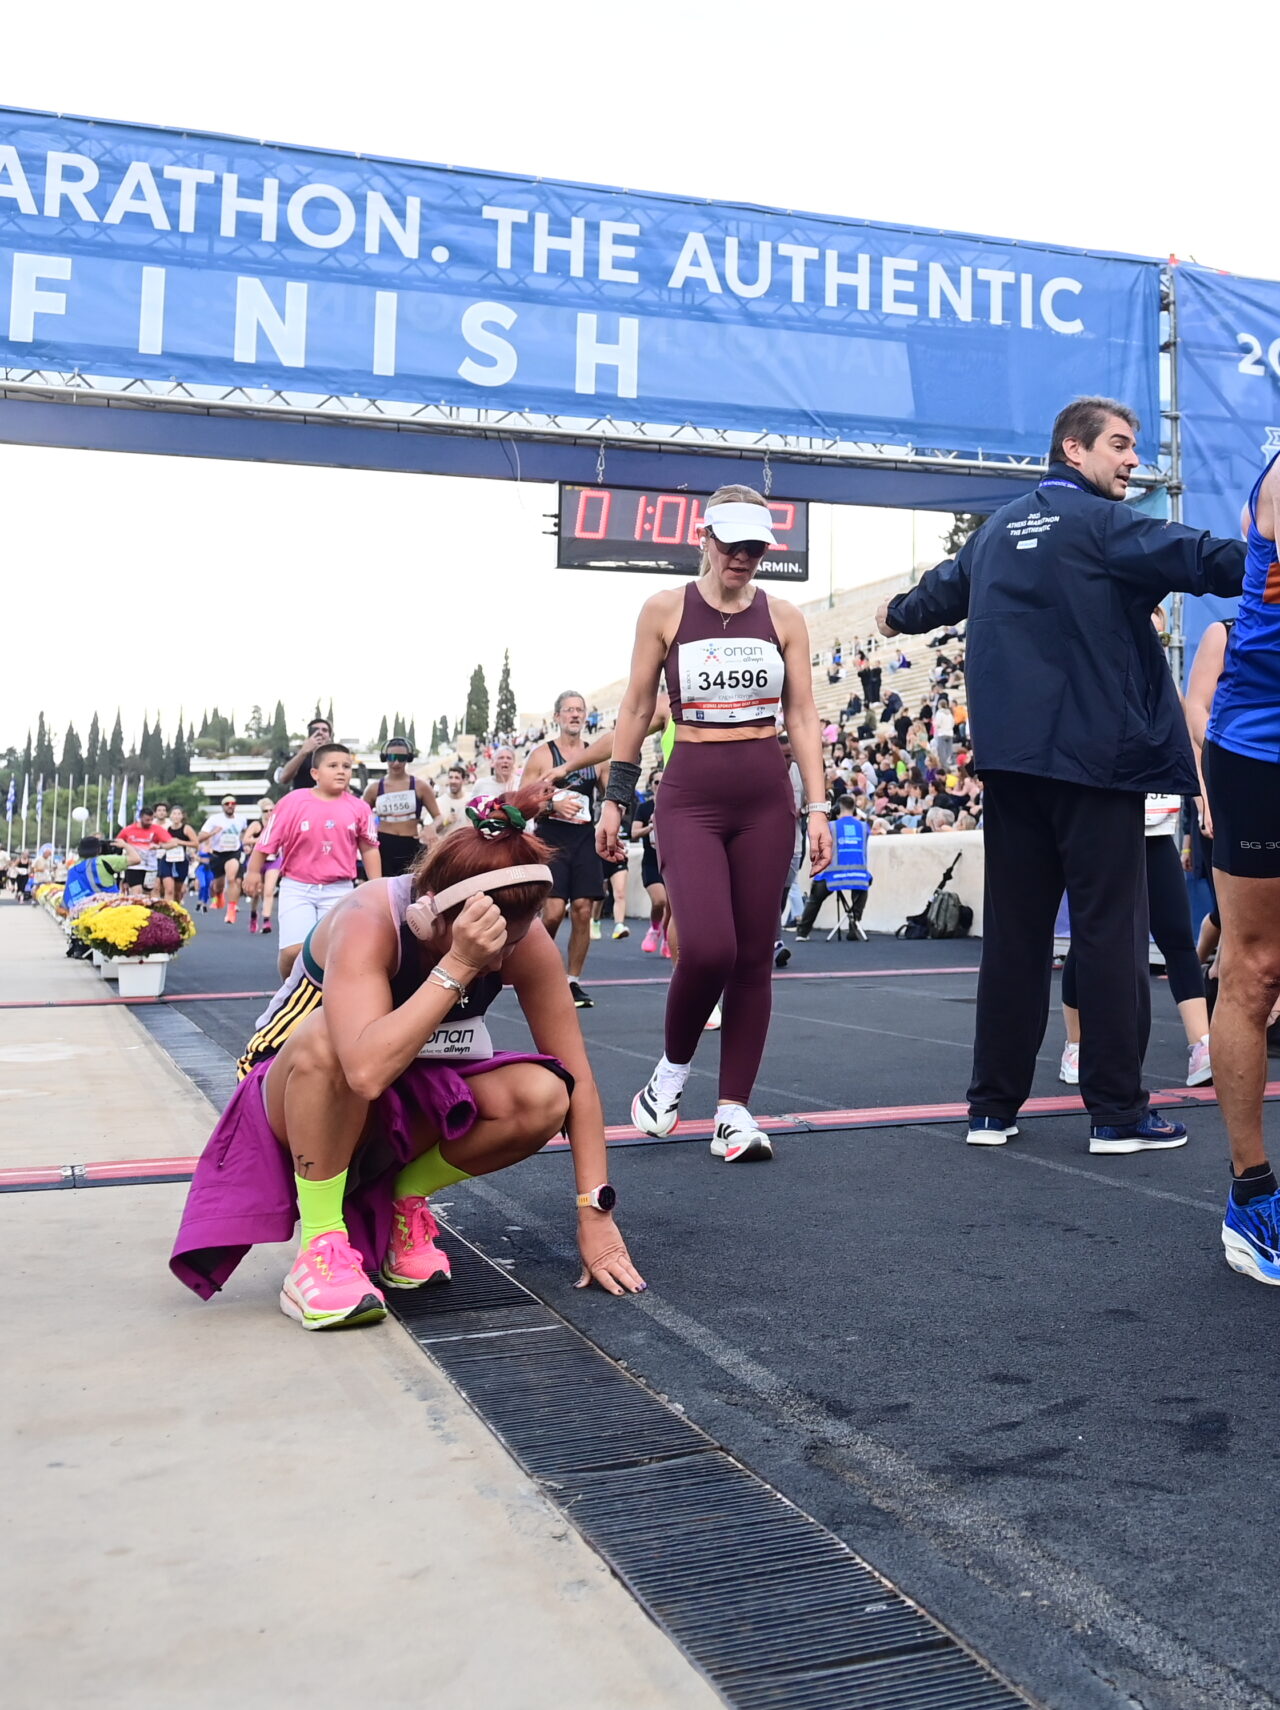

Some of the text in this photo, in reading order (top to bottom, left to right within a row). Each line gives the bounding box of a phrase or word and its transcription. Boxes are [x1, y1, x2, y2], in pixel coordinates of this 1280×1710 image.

[482, 204, 641, 284] THE
[668, 231, 1086, 335] AUTHENTIC
[9, 252, 639, 398] FINISH
[698, 668, 768, 691] 34596
[1240, 840, 1262, 850] BG
[443, 1045, 471, 1055] allwyn
